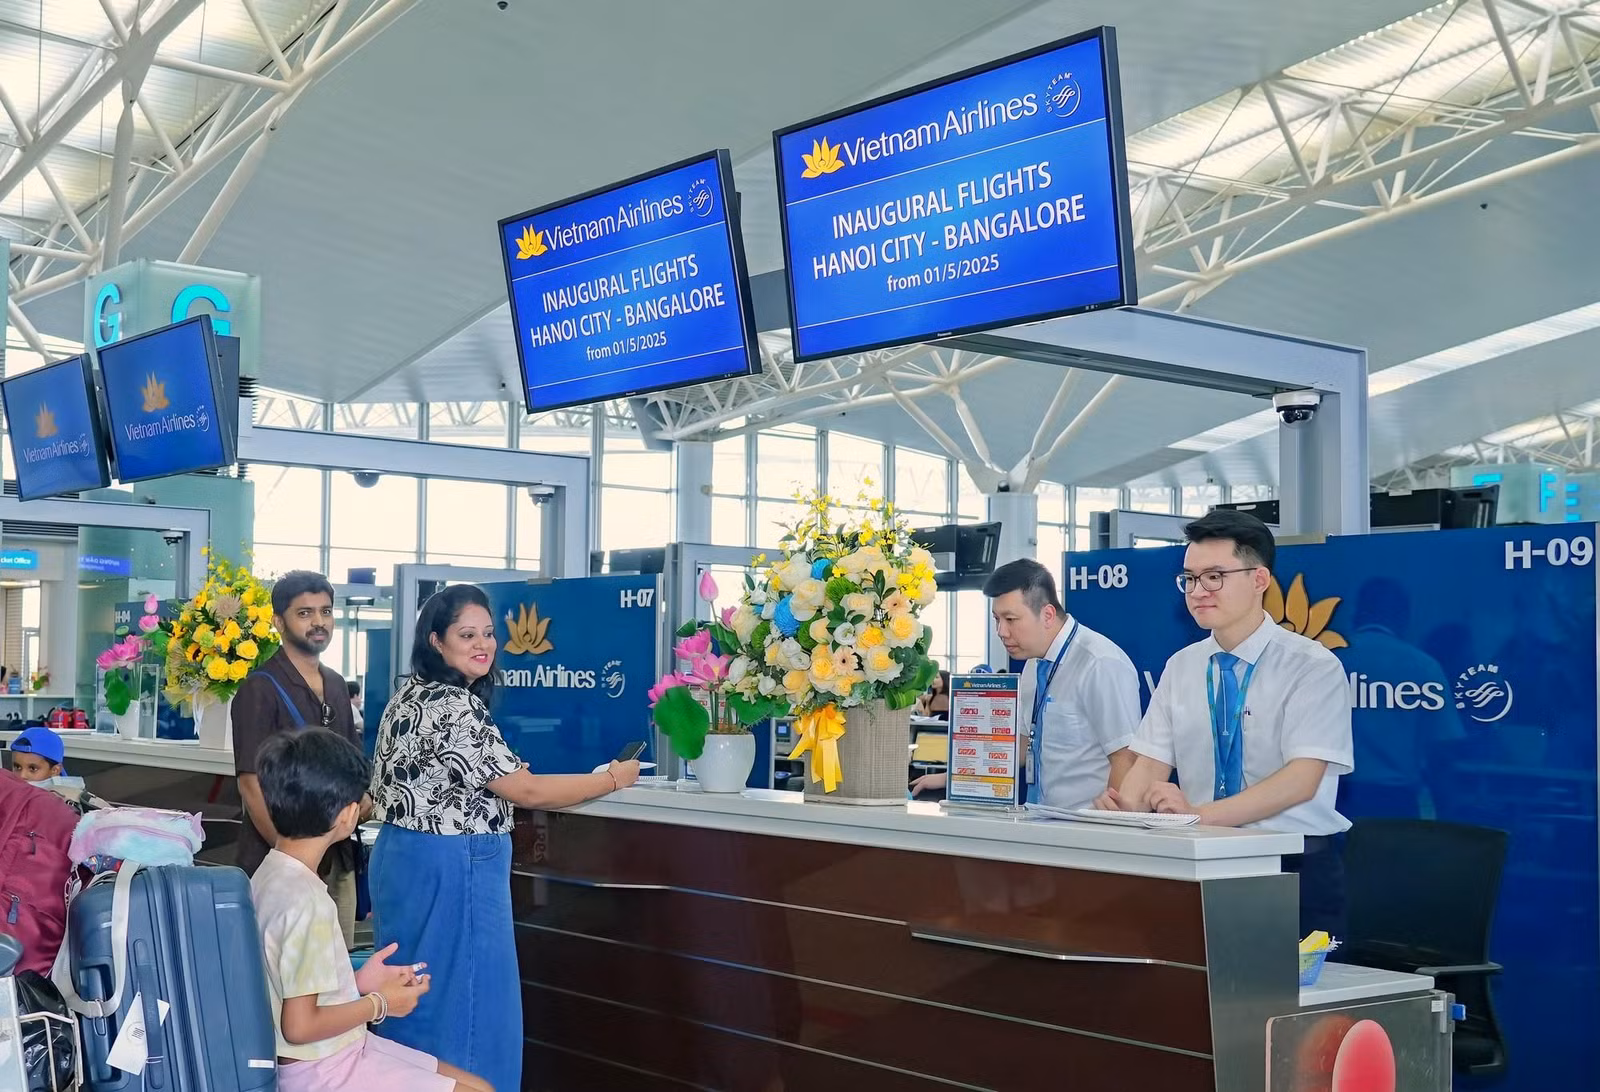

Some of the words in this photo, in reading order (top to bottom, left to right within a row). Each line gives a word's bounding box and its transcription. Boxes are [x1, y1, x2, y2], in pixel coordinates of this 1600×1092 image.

[843, 124, 941, 165] Vietnam
[942, 92, 1038, 140] Airlines
[832, 189, 953, 239] INAUGURAL
[957, 161, 1053, 208] FLIGHTS
[545, 215, 616, 251] Vietnam
[617, 195, 684, 231] Airlines
[813, 246, 877, 280] HANOI
[880, 231, 926, 264] CITY
[944, 194, 1086, 251] BANGALORE
[542, 273, 629, 314] INAUGURAL
[631, 254, 699, 291] FLIGHTS
[886, 273, 921, 292] from
[924, 253, 1000, 285] 01/5/2025
[93, 283, 121, 347] G
[530, 317, 578, 348] HANOI
[580, 309, 612, 337] CITY
[625, 283, 726, 327] BANGALORE
[586, 346, 612, 361] from
[612, 331, 668, 355] 01/5/2025
[124, 420, 162, 442] Vietnam
[161, 413, 196, 432] Airlines
[23, 446, 51, 464] Vietnam
[1539, 473, 1556, 513] F
[1504, 536, 1593, 570] H-09
[1069, 564, 1129, 590] H-08
[620, 588, 655, 608] H-07
[533, 664, 596, 689] Airlines
[1350, 671, 1445, 711] lines
[1454, 664, 1499, 709] SKYTEAM
